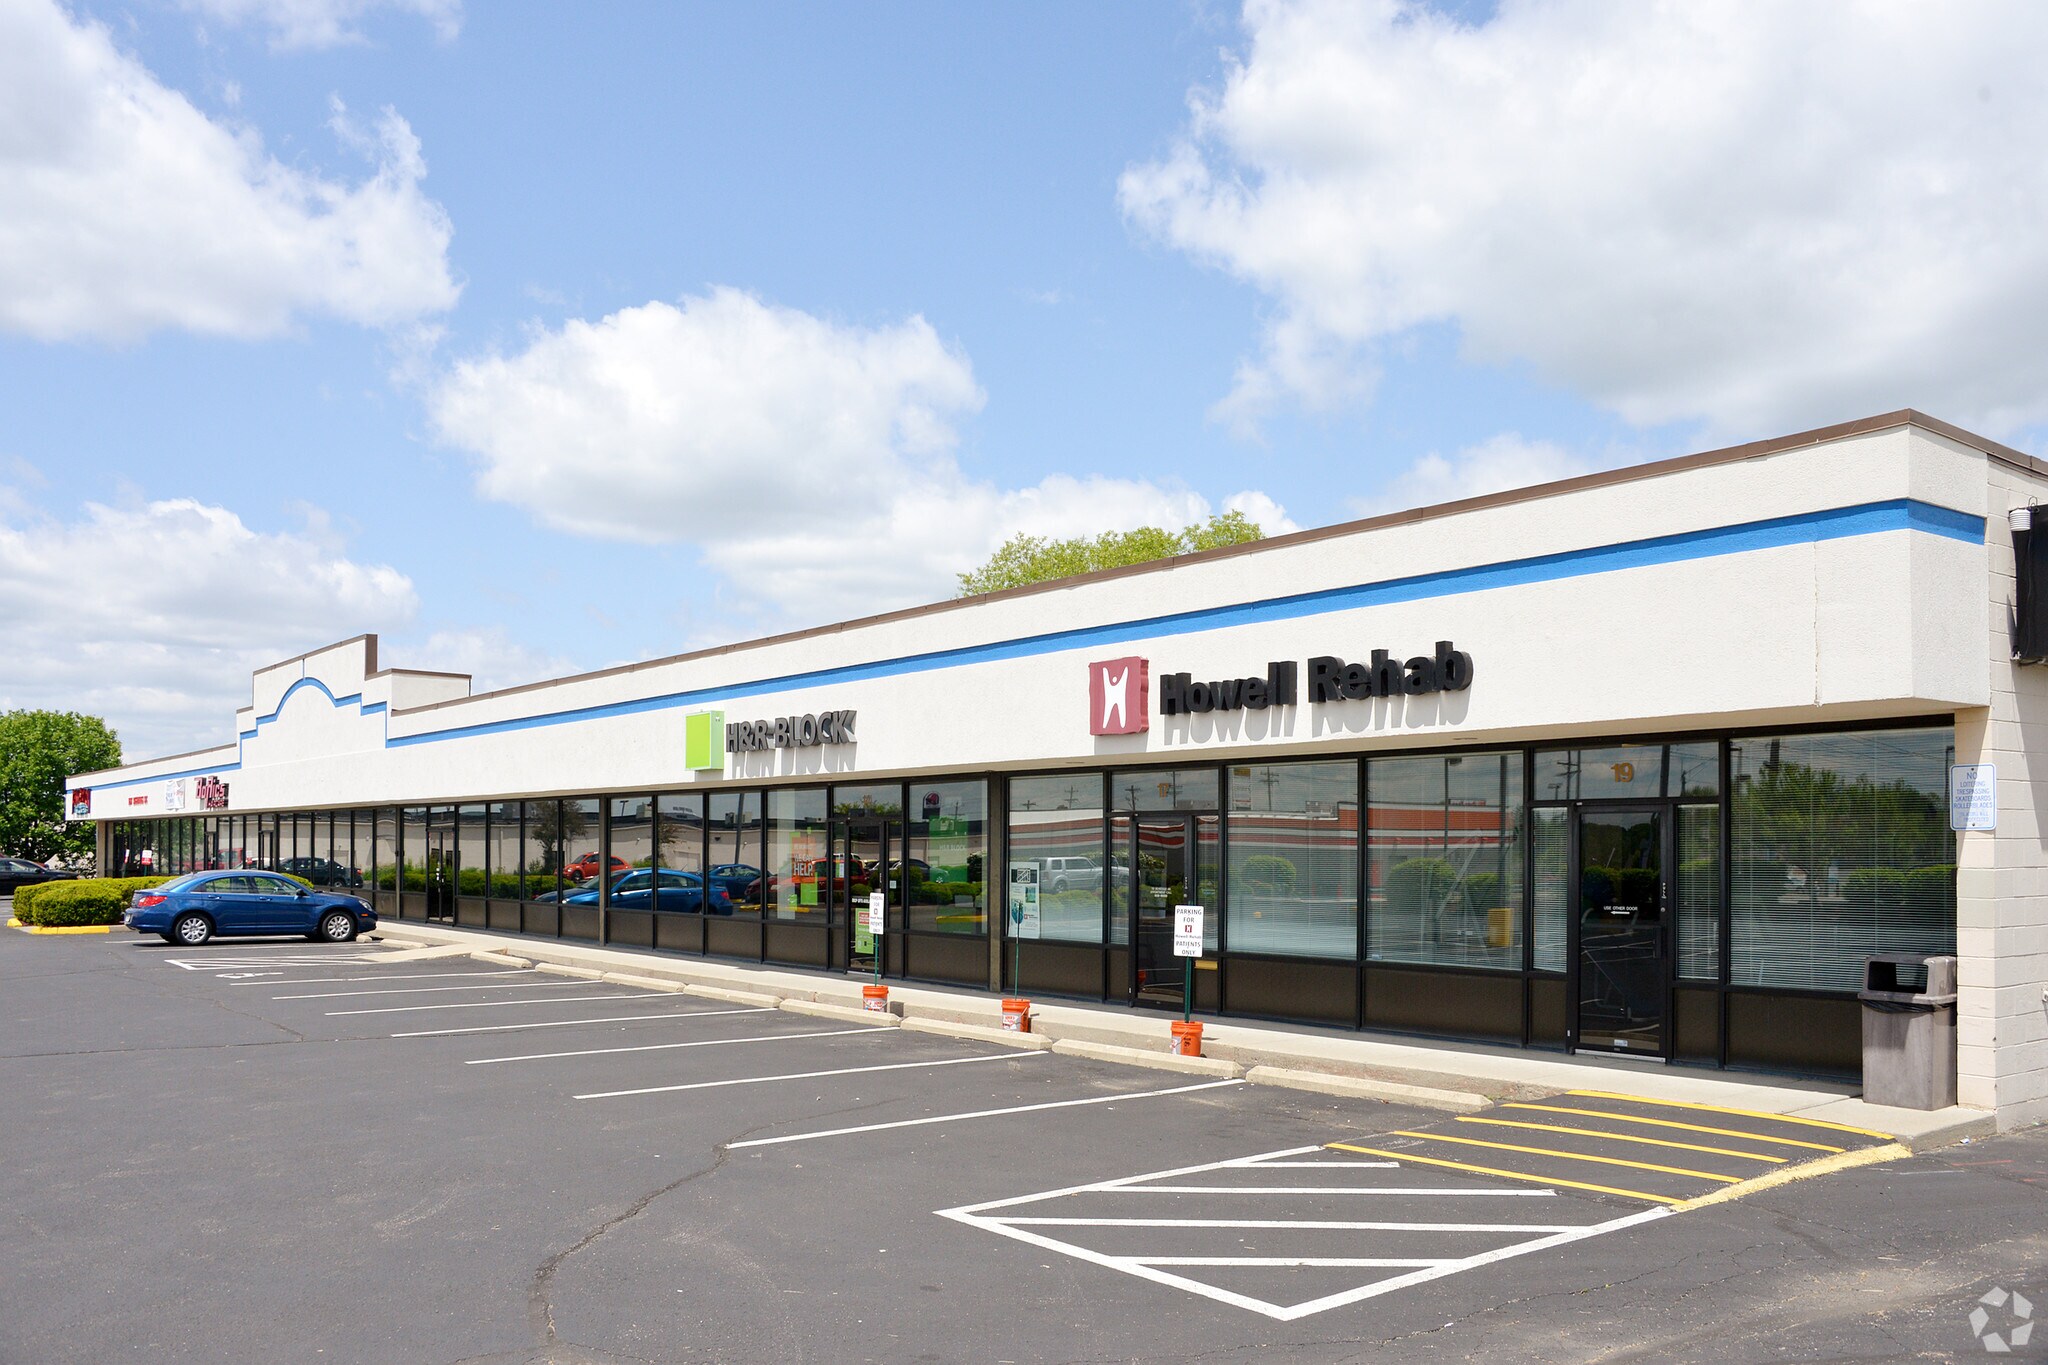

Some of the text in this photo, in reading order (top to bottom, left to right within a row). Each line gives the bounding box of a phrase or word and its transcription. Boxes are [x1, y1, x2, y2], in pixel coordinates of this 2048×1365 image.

[1160, 640, 1474, 714] Howell Rehab
[775, 709, 857, 748] BLOCK
[1611, 762, 1633, 782] 19
